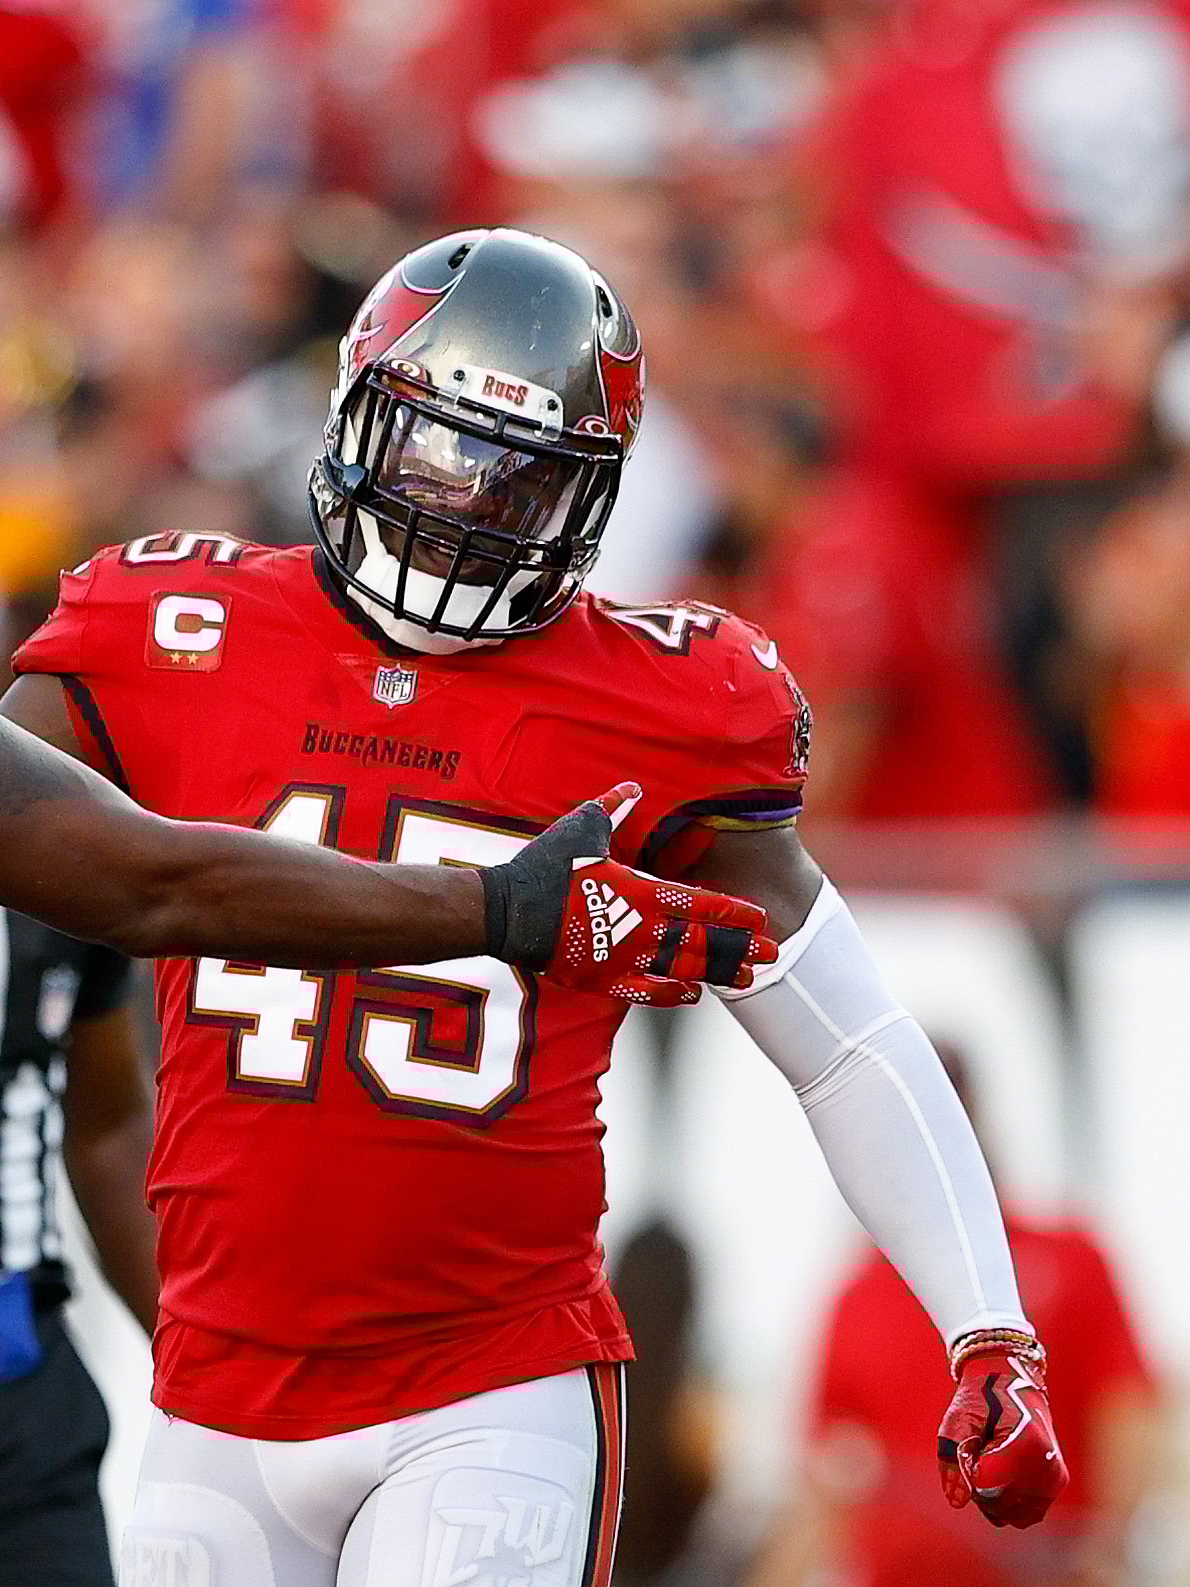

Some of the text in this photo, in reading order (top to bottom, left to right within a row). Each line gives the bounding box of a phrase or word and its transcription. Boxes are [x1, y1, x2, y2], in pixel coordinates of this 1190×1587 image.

[482, 374, 529, 407] BUCS
[153, 594, 226, 652] C
[379, 680, 408, 699] NFL
[301, 723, 462, 780] BUCCANEERS
[581, 878, 611, 962] adidas
[186, 782, 540, 1129] 45
